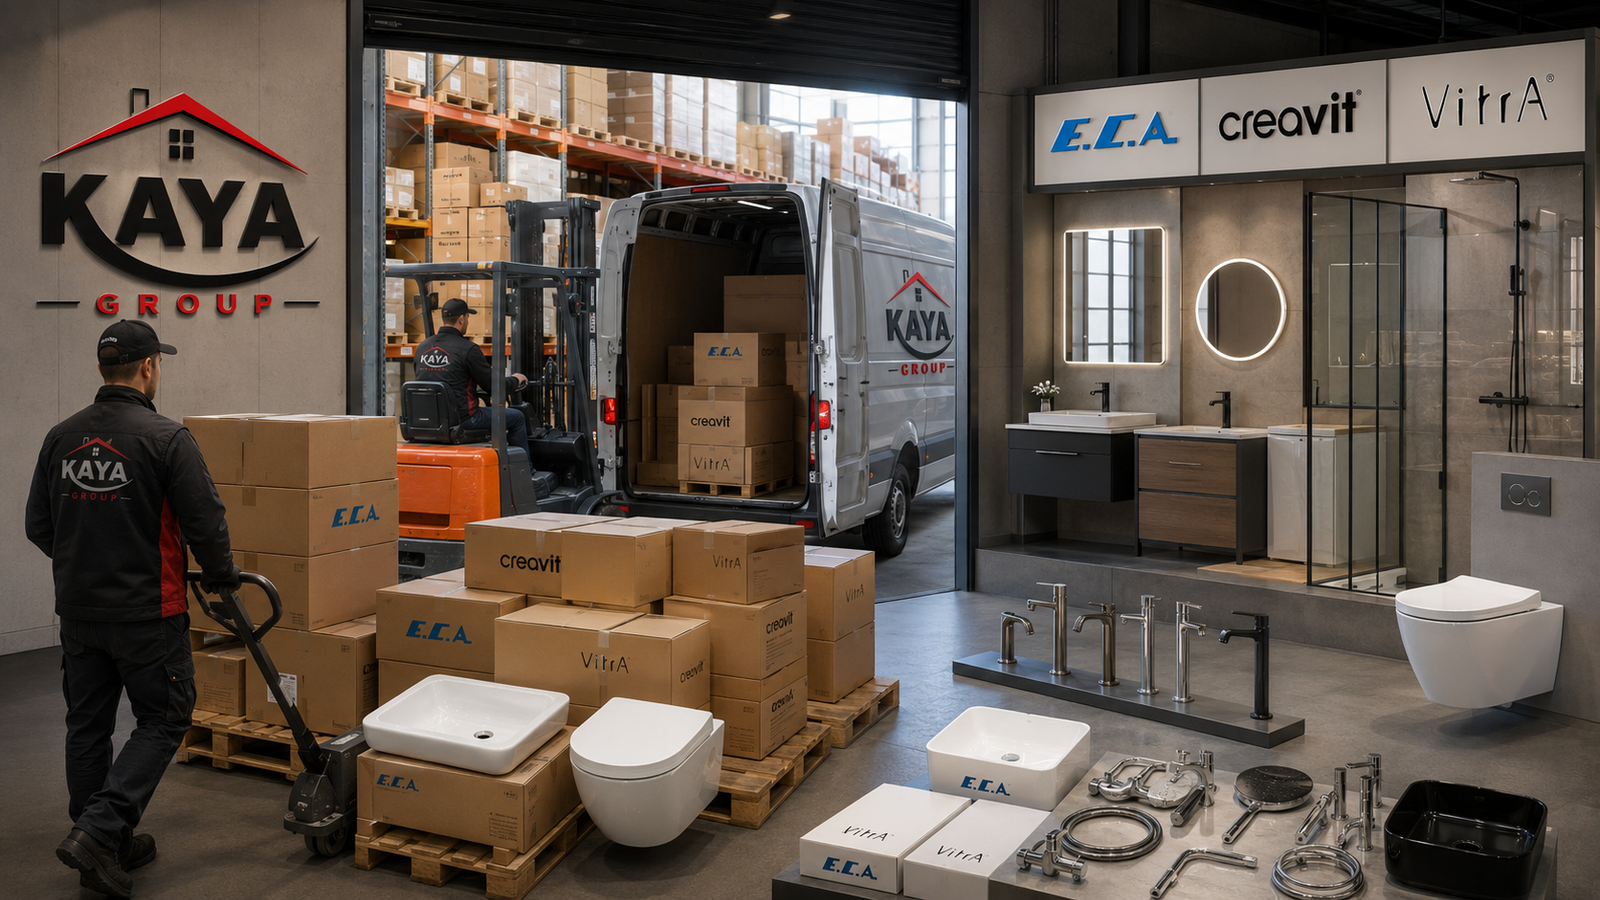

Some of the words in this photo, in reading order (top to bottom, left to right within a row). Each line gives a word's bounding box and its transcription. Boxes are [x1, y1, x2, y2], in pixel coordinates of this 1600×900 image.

[41, 171, 305, 249] KAYA
[96, 293, 273, 315] GROUP
[885, 308, 950, 342] KAYA
[420, 353, 450, 366] KAYA
[901, 362, 946, 376] GROUP
[690, 416, 731, 428] creavit
[61, 459, 128, 485] KAYA
[693, 456, 730, 471] VitrA
[71, 491, 117, 502] GROUP
[499, 554, 562, 574] creavit
[712, 554, 741, 569] VitrA
[765, 610, 794, 635] creavit
[580, 651, 629, 674] VitrA
[843, 825, 889, 842] VitrA
[937, 845, 983, 864] VitrA
